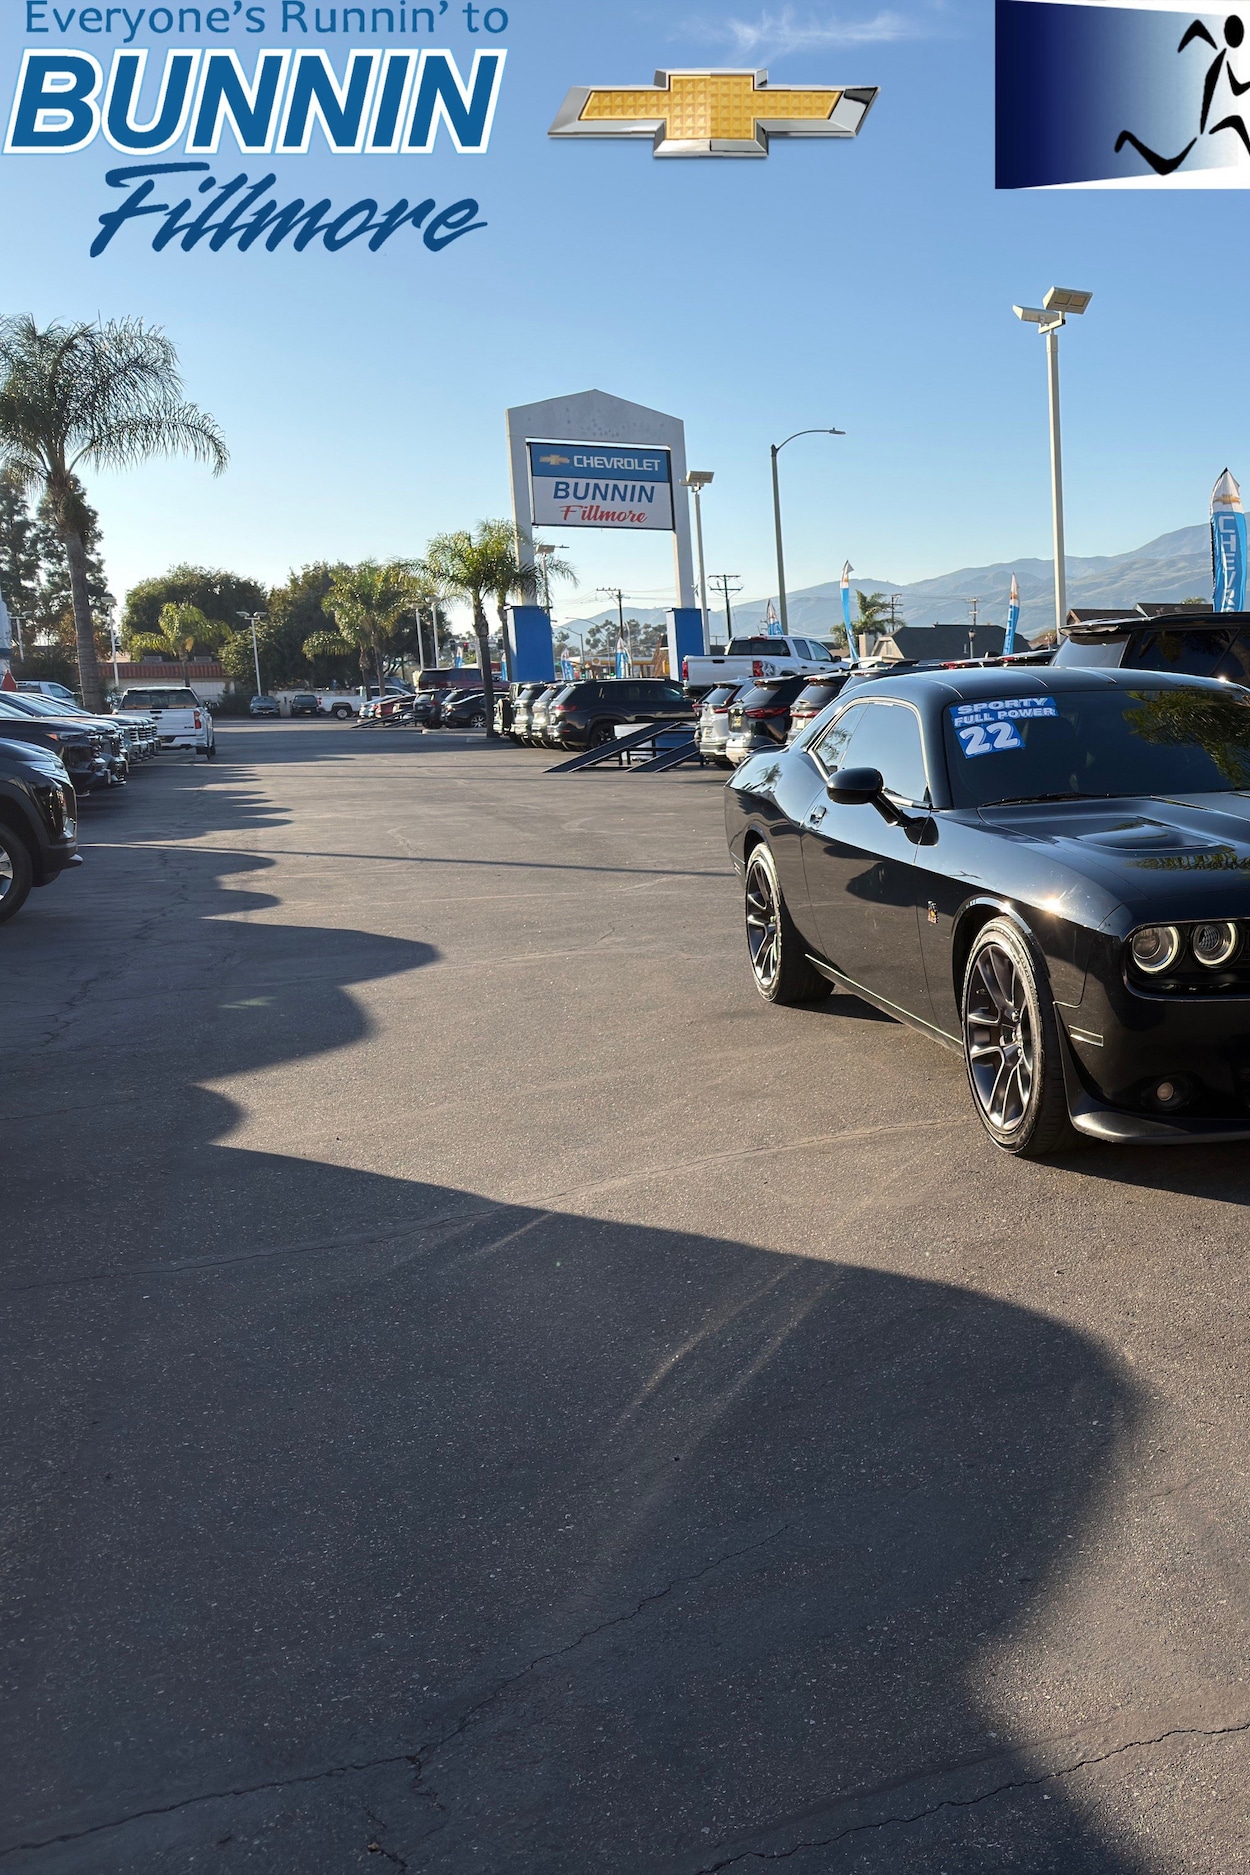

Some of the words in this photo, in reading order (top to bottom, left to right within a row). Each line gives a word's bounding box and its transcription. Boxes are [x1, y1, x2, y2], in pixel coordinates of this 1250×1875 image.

[573, 455, 661, 471] CHEVROLET
[553, 481, 655, 503] BUNNIN
[558, 504, 648, 524] Fillmore
[957, 697, 1048, 715] SPORTY
[954, 713, 995, 727] FULL
[997, 707, 1056, 720] POWER
[959, 722, 1021, 756] 22
